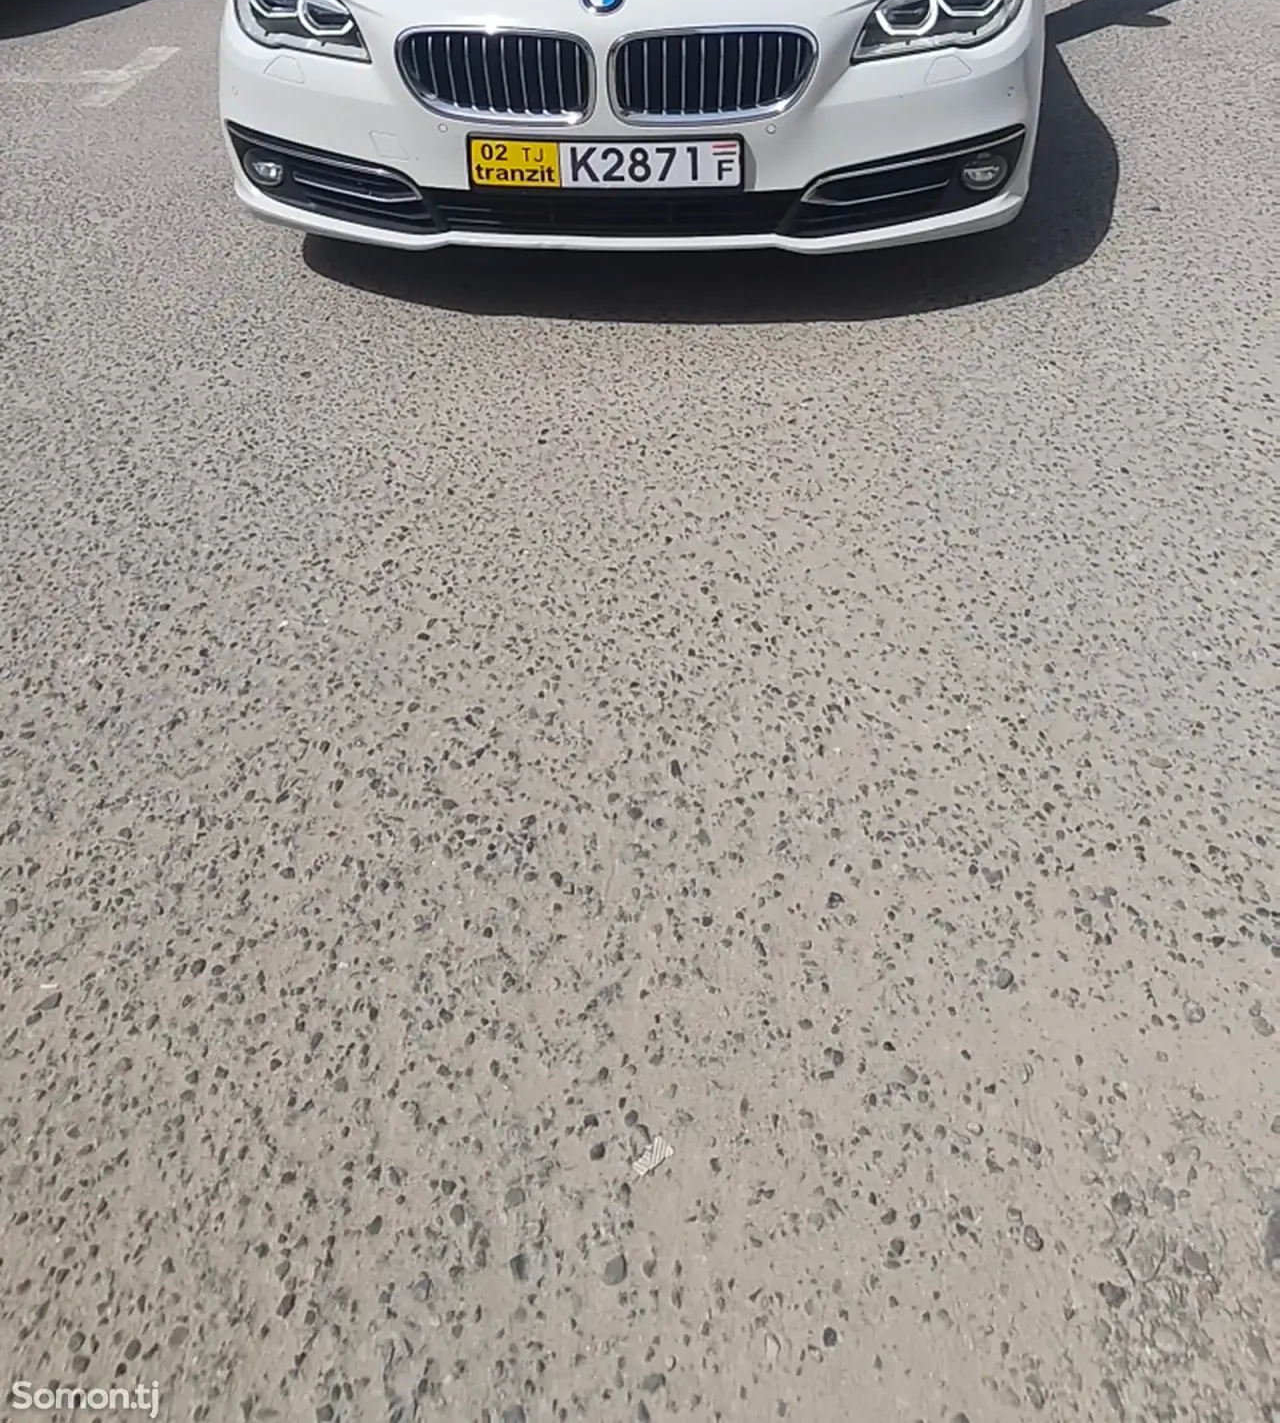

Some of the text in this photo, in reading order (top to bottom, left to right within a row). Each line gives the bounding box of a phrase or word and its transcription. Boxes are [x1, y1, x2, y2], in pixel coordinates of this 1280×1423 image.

[481, 144, 544, 162] 02 TJ
[474, 164, 555, 183] tranzit
[570, 147, 734, 182] K2871 F
